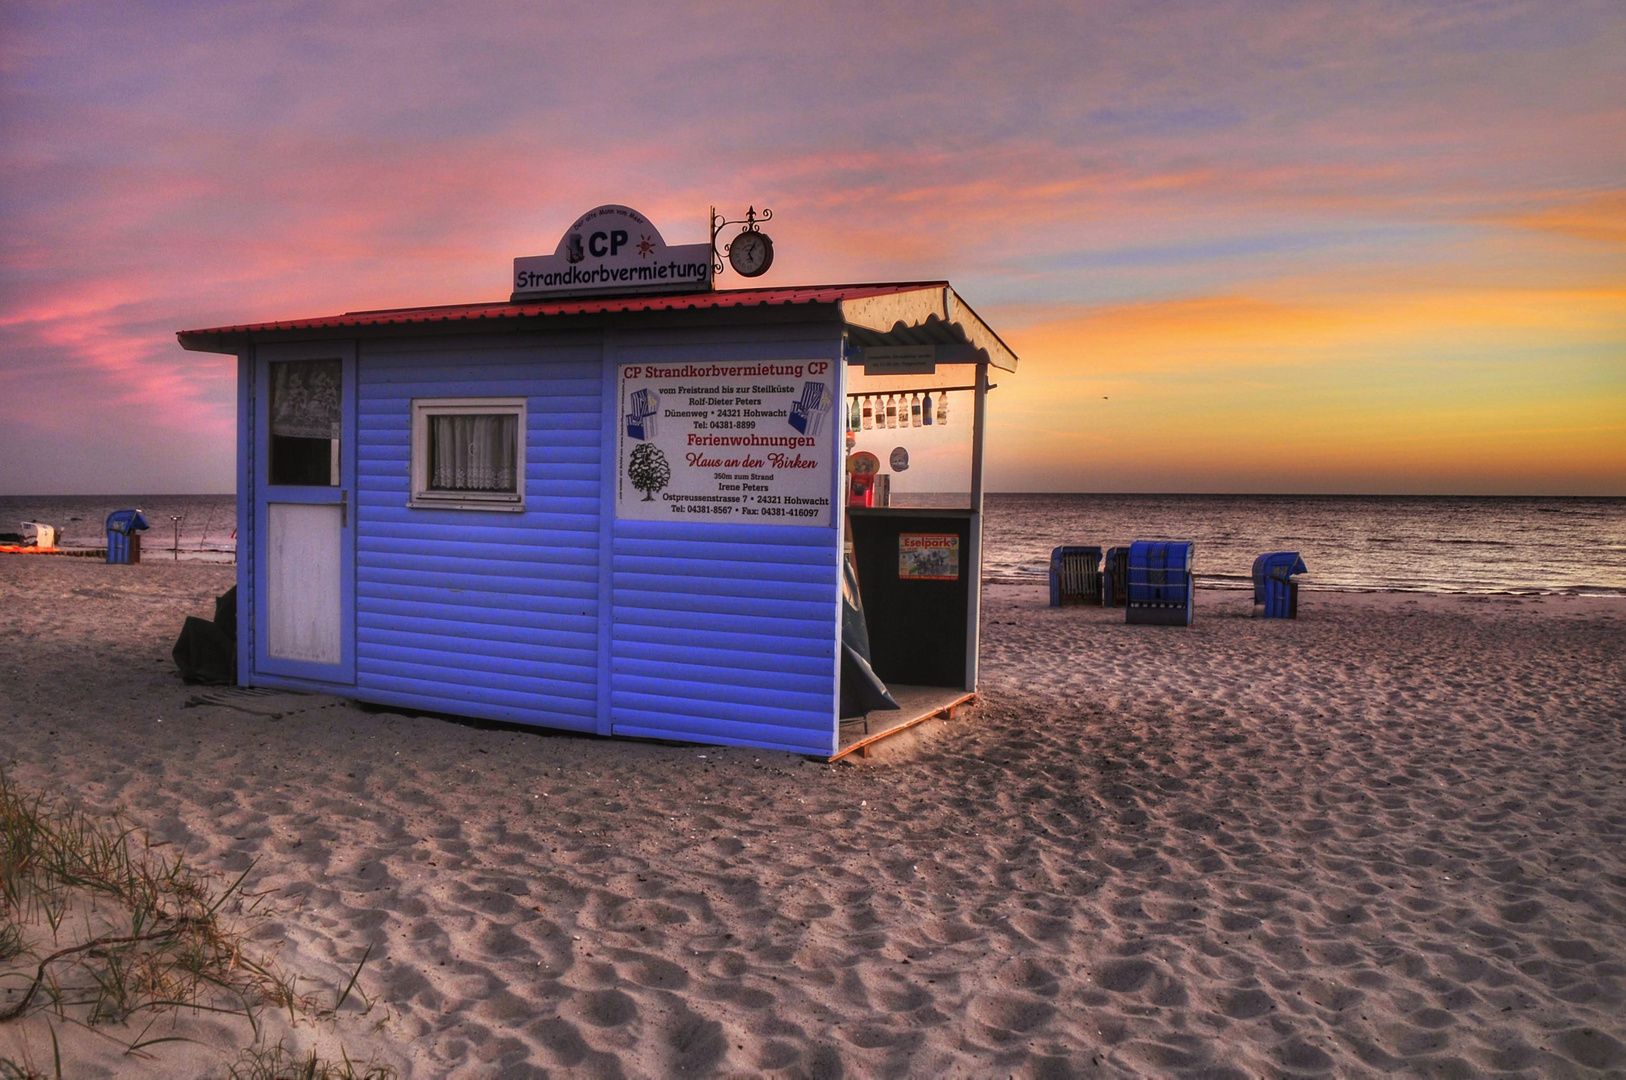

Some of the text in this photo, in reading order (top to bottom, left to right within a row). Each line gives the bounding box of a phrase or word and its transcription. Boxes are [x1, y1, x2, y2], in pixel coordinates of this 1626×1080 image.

[629, 212, 644, 224] Meer
[589, 230, 628, 257] CP
[517, 262, 706, 287] Strandkorbvermietung
[624, 362, 828, 379] CP Strandkorbvermietung CP
[678, 386, 719, 394] Freistrand
[753, 385, 795, 393] Steilküste
[665, 410, 708, 419] Dünenweg
[744, 409, 787, 417] Hohwacht
[710, 421, 756, 429] 04381-8899
[687, 434, 815, 449] Ferienwohnungen
[686, 453, 818, 469] Haus an den Birken
[663, 493, 740, 503] Ostpreussenstrasse
[784, 497, 829, 505] Hohwacht
[688, 506, 732, 514] 04381-8567
[761, 508, 819, 517] 04381-416097
[904, 538, 950, 549] Eselpark
